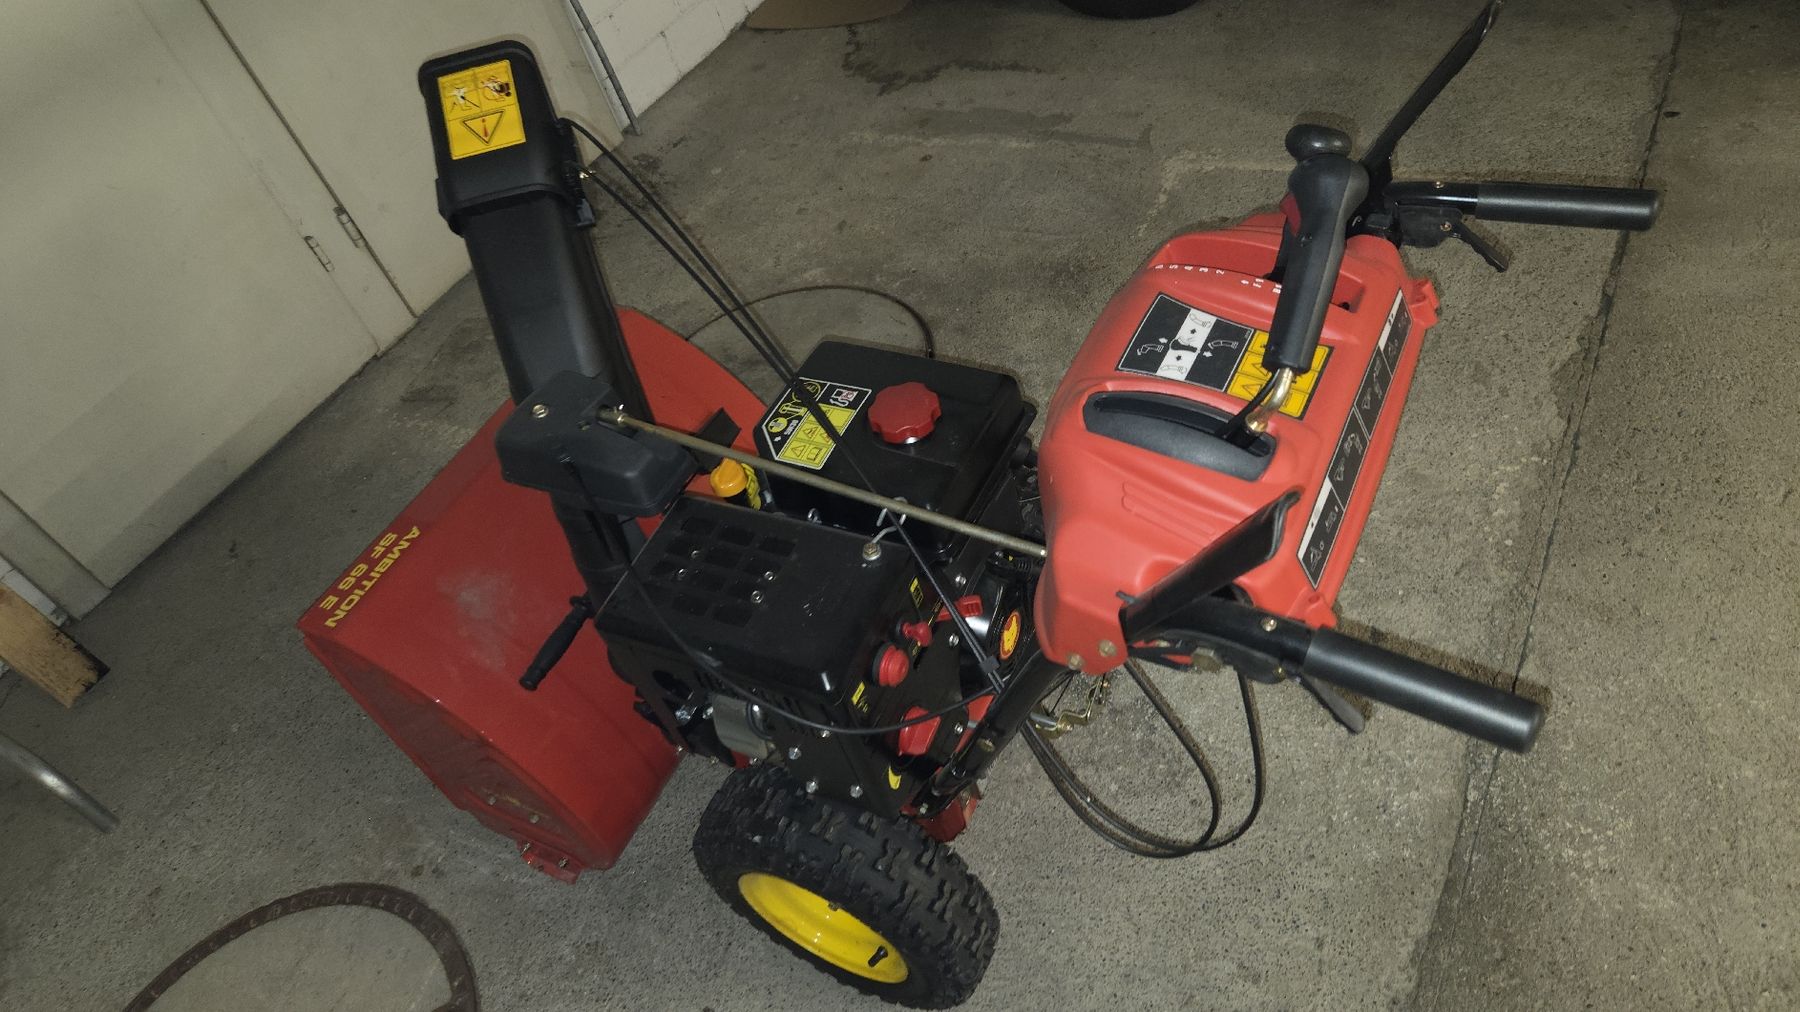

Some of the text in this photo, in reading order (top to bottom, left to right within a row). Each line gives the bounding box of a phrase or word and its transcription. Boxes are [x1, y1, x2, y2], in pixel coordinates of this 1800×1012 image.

[319, 532, 399, 610] SF 66 E
[324, 525, 421, 628] AMBITION
